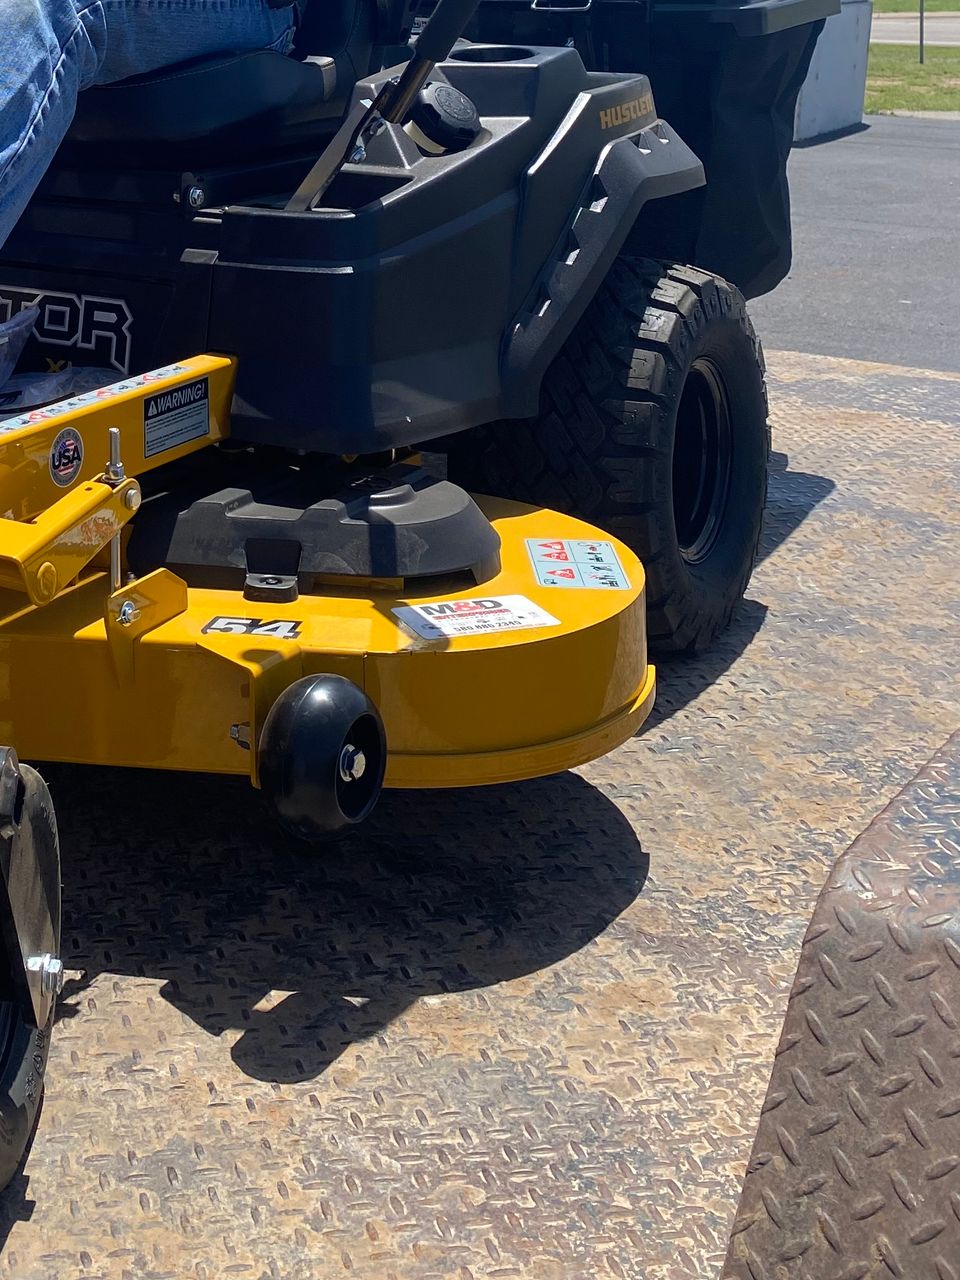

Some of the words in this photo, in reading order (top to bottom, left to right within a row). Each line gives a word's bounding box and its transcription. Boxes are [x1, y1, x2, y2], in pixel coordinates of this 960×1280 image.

[157, 382, 205, 413] WARNING!
[51, 444, 81, 470] USA
[419, 600, 503, 616] M&D
[203, 616, 301, 639] 54
